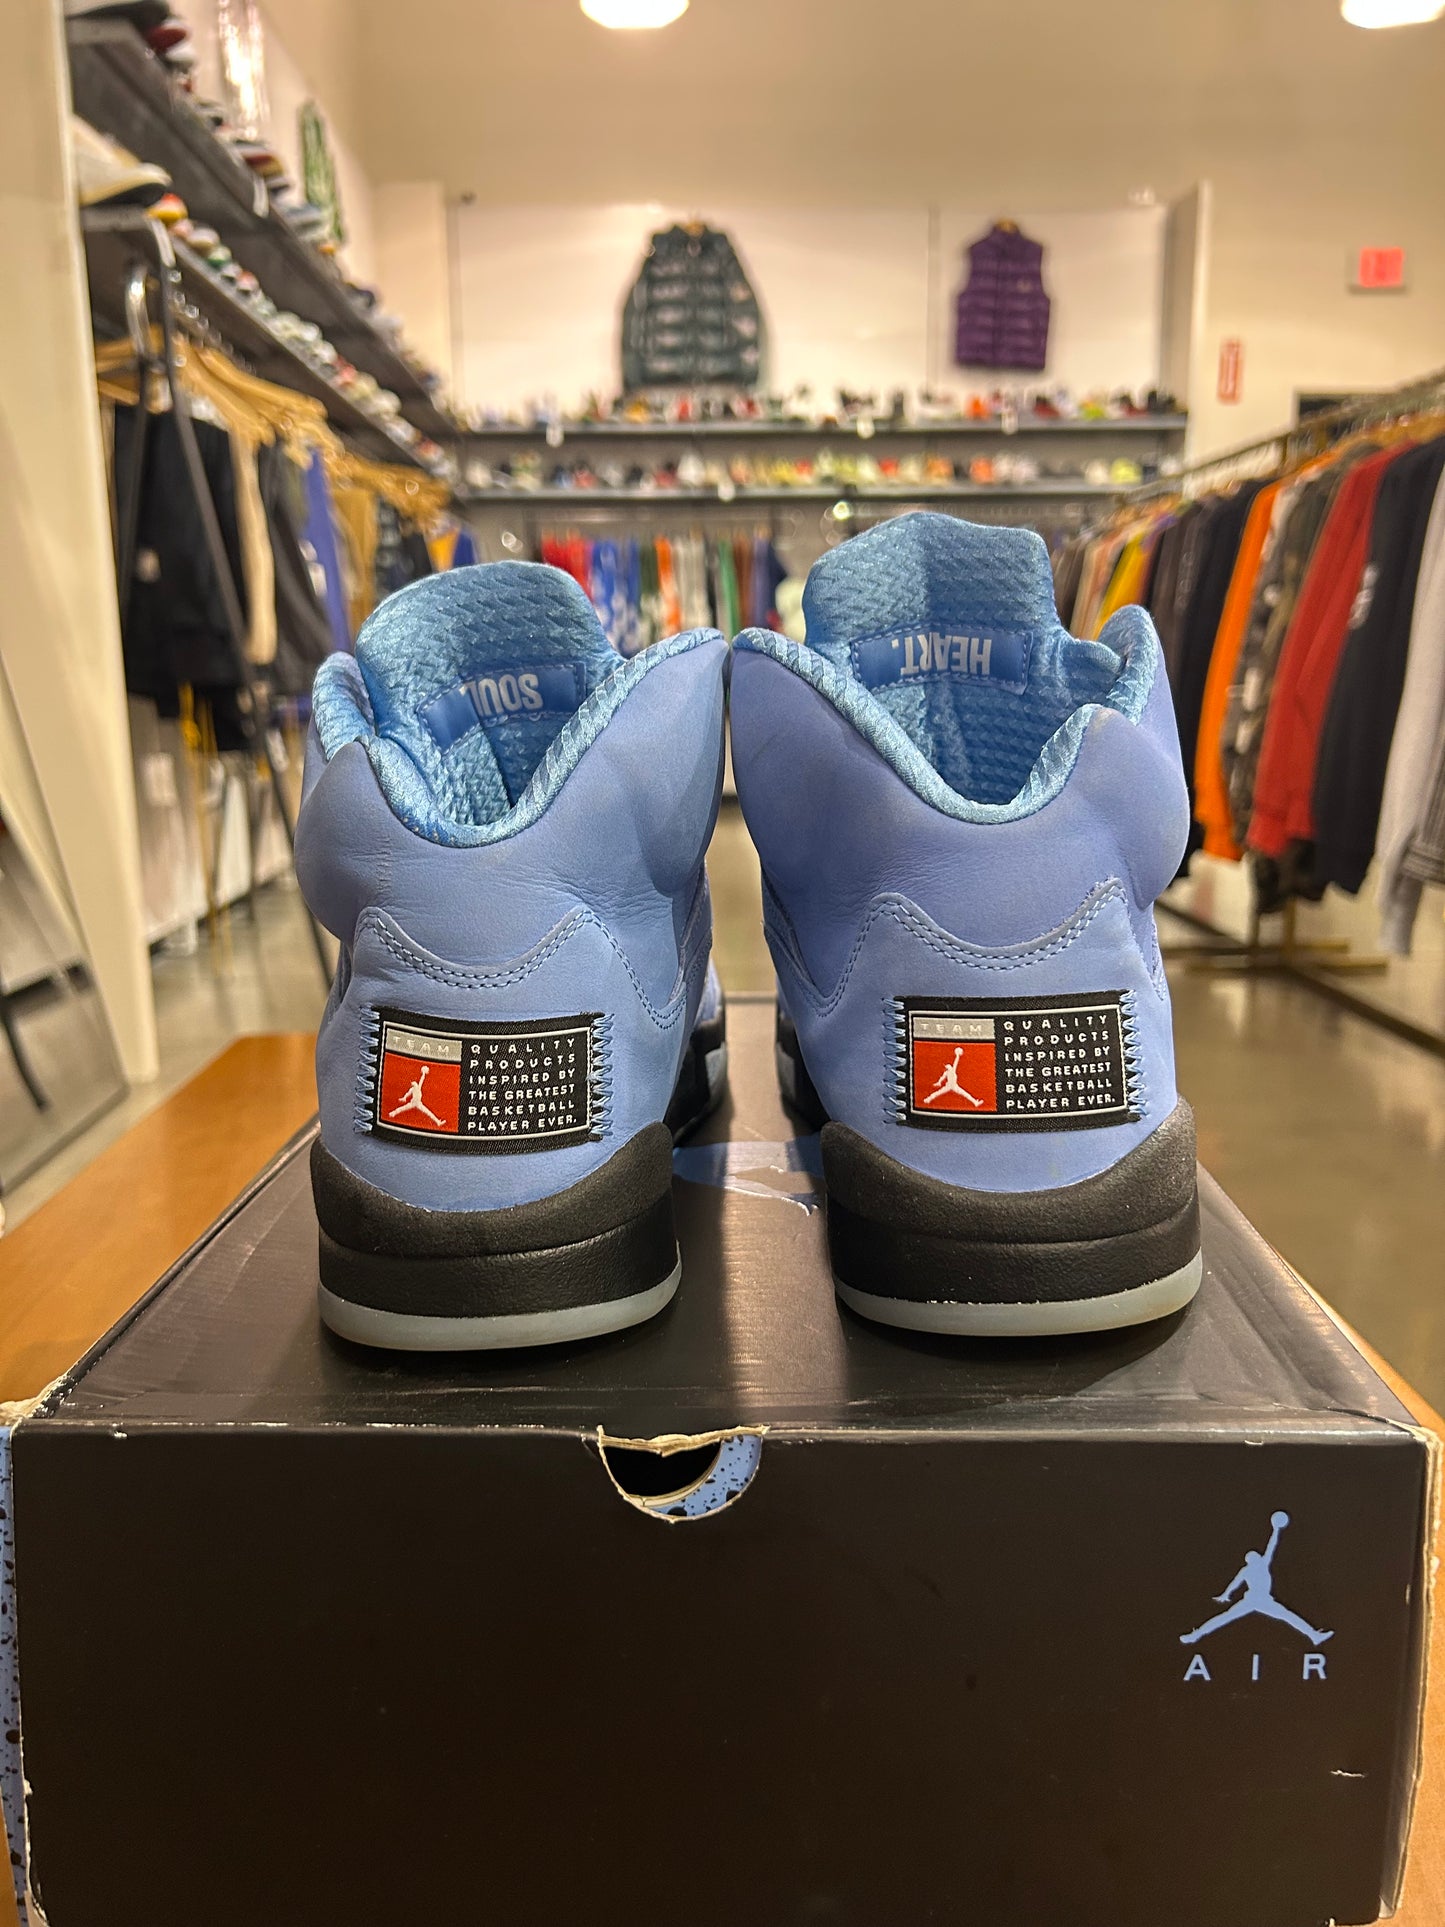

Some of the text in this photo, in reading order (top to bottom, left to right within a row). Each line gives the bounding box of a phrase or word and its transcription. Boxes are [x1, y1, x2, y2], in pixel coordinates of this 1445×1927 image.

[891, 632, 992, 676] HEART.
[922, 1022, 983, 1034] TEAM
[1003, 1014, 1108, 1032] QUALITY
[392, 1035, 451, 1054] TEAM
[470, 1037, 576, 1056] QUALITY
[1004, 1031, 1110, 1047] PRODUCTS
[469, 1053, 576, 1071] PRODUCTS
[1004, 1046, 1111, 1063] INSPIRED BY
[469, 1068, 576, 1086] INSPIRED BY
[1005, 1061, 1112, 1079] THE GREATEST
[468, 1083, 576, 1101] THE GREATEST
[1005, 1079, 1112, 1095] BASKETBALL
[467, 1101, 576, 1117] BASKETBALL
[1006, 1093, 1116, 1110] PLAYER EVER.
[467, 1115, 578, 1132] PLAYER EVER.
[1183, 1653, 1327, 1681] AIR
